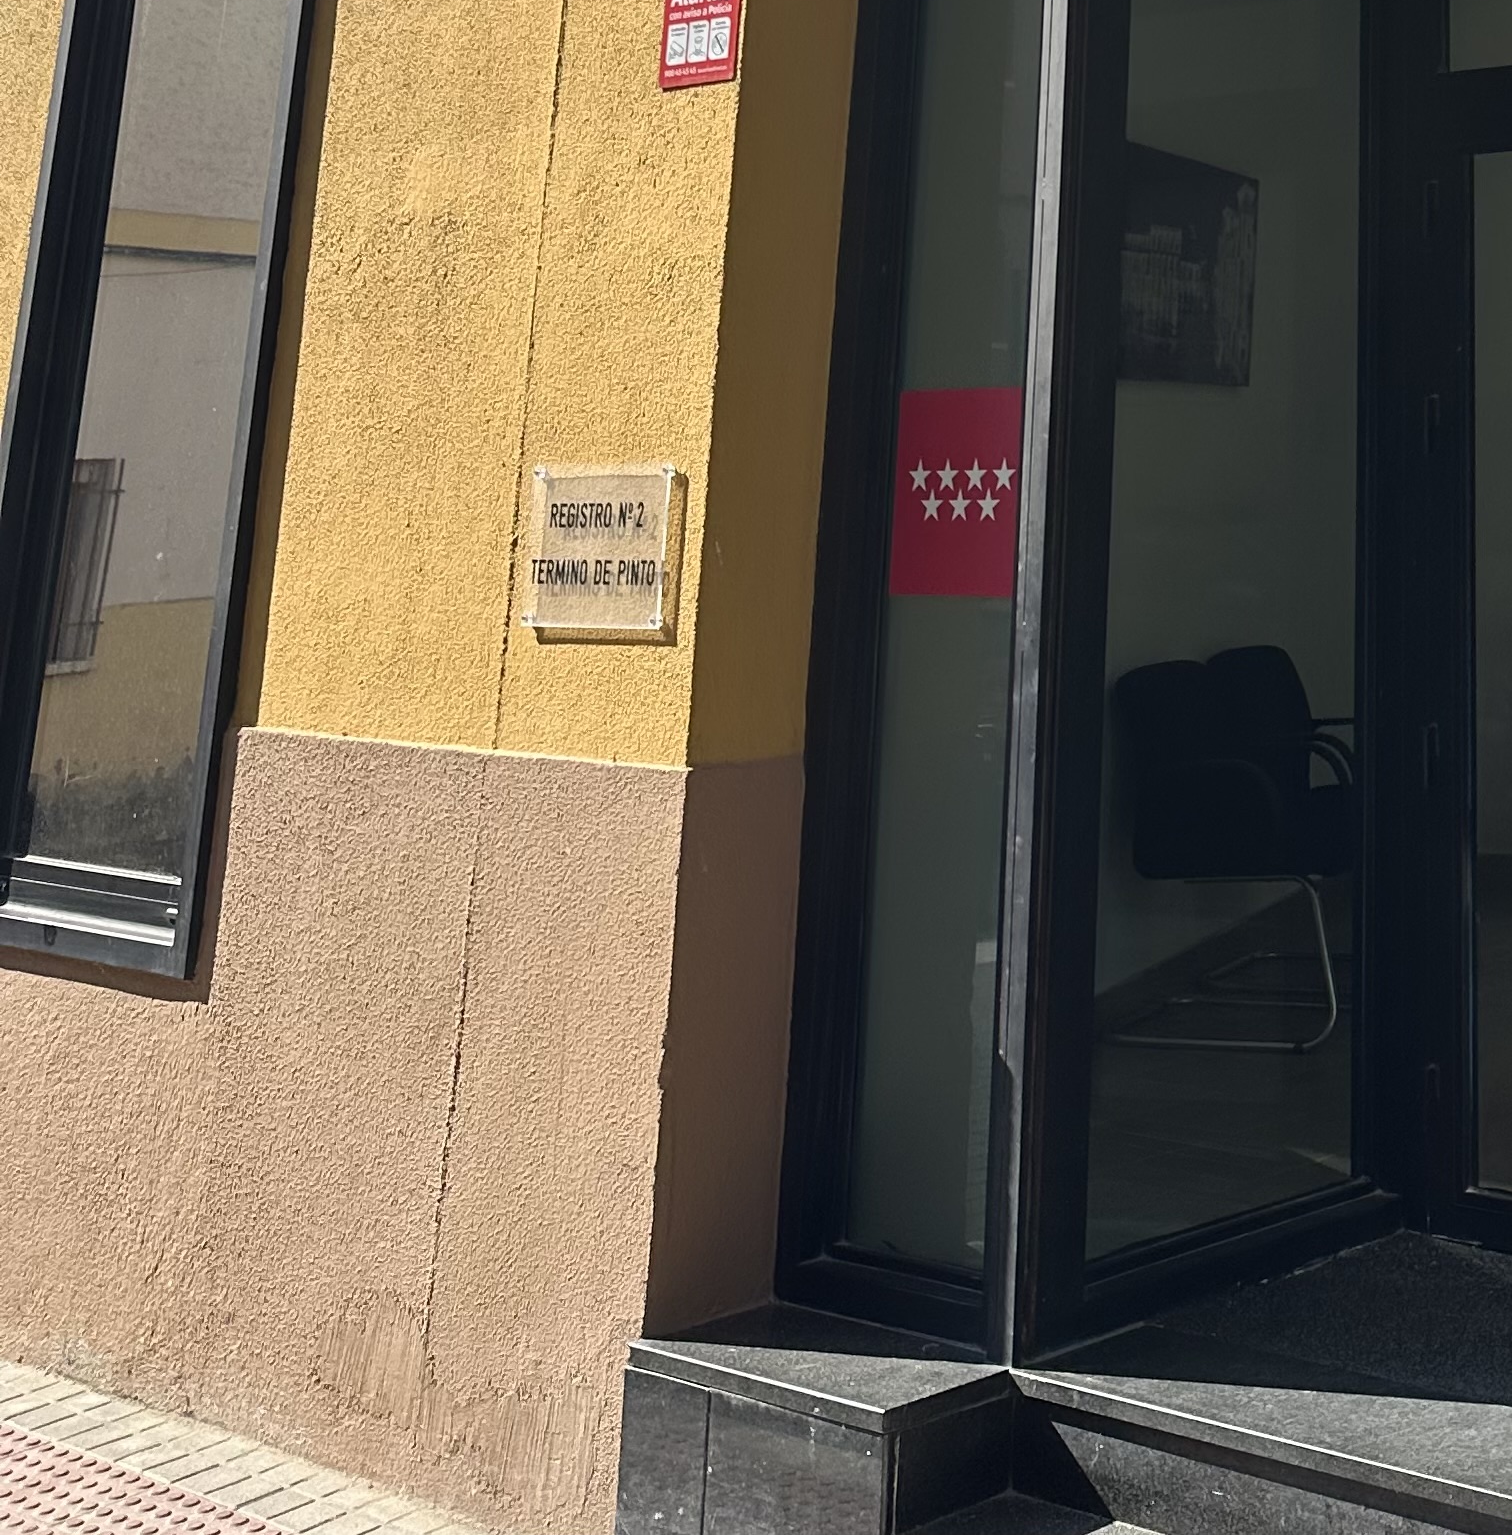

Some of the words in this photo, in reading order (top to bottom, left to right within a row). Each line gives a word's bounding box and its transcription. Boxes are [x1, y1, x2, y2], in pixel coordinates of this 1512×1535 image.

[550, 502, 613, 529] REGISTRO
[636, 501, 645, 528] 2
[532, 559, 588, 586] TERMINO
[593, 560, 611, 586] DE
[616, 560, 656, 586] PINTO
